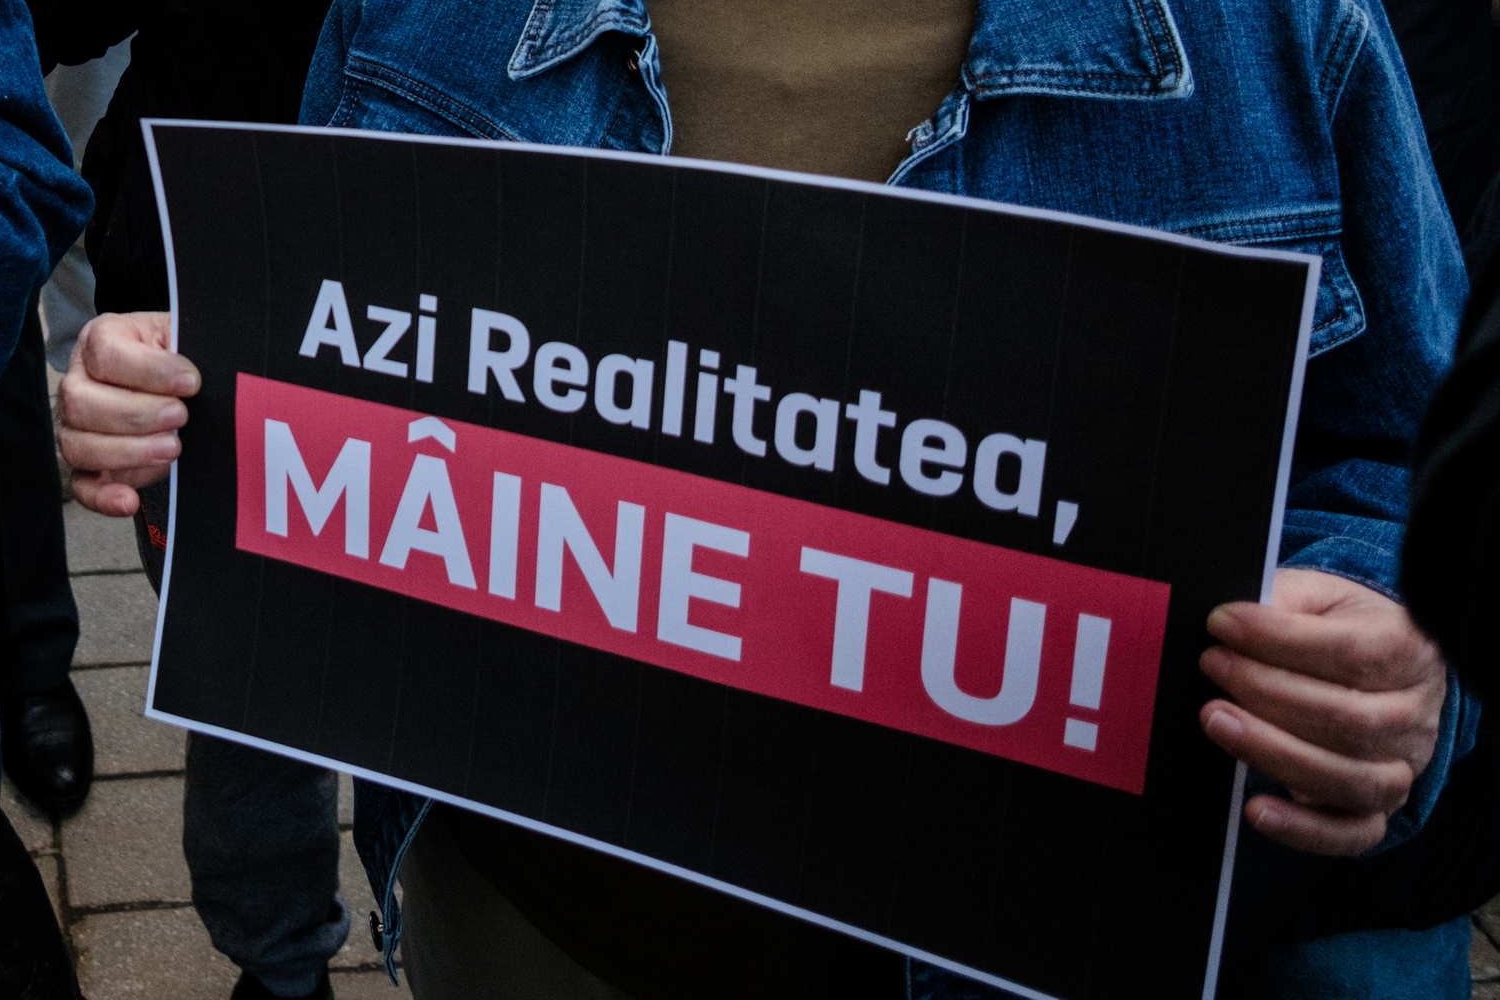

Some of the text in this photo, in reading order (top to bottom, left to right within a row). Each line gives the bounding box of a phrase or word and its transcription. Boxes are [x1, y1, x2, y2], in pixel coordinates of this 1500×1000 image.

[299, 279, 1079, 544] Azi Realitatea,
[264, 416, 1112, 752] MÂINE TU!
